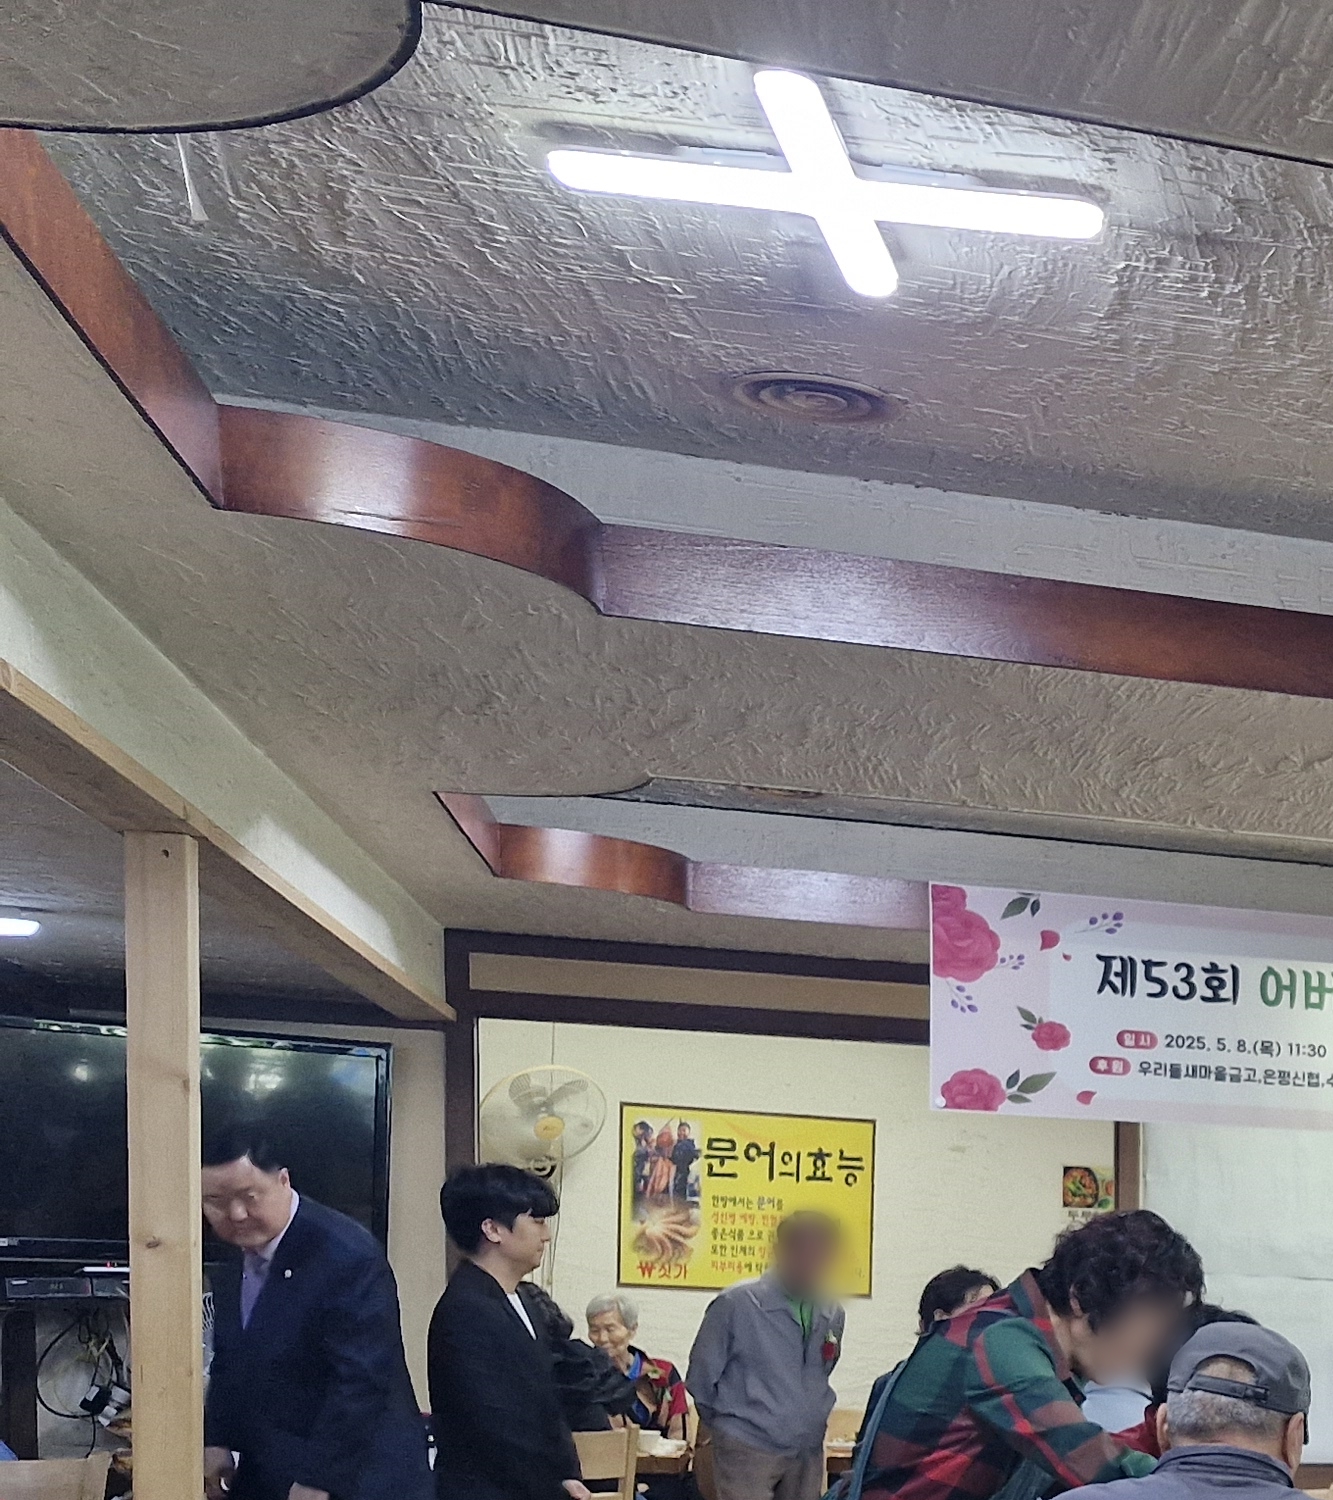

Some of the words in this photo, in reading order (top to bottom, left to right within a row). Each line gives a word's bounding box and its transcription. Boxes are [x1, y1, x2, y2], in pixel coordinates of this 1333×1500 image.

[1096, 953, 1240, 1006] 제53회
[1164, 1034, 1211, 1052] 2025.
[1287, 1042, 1327, 1059] 11:30
